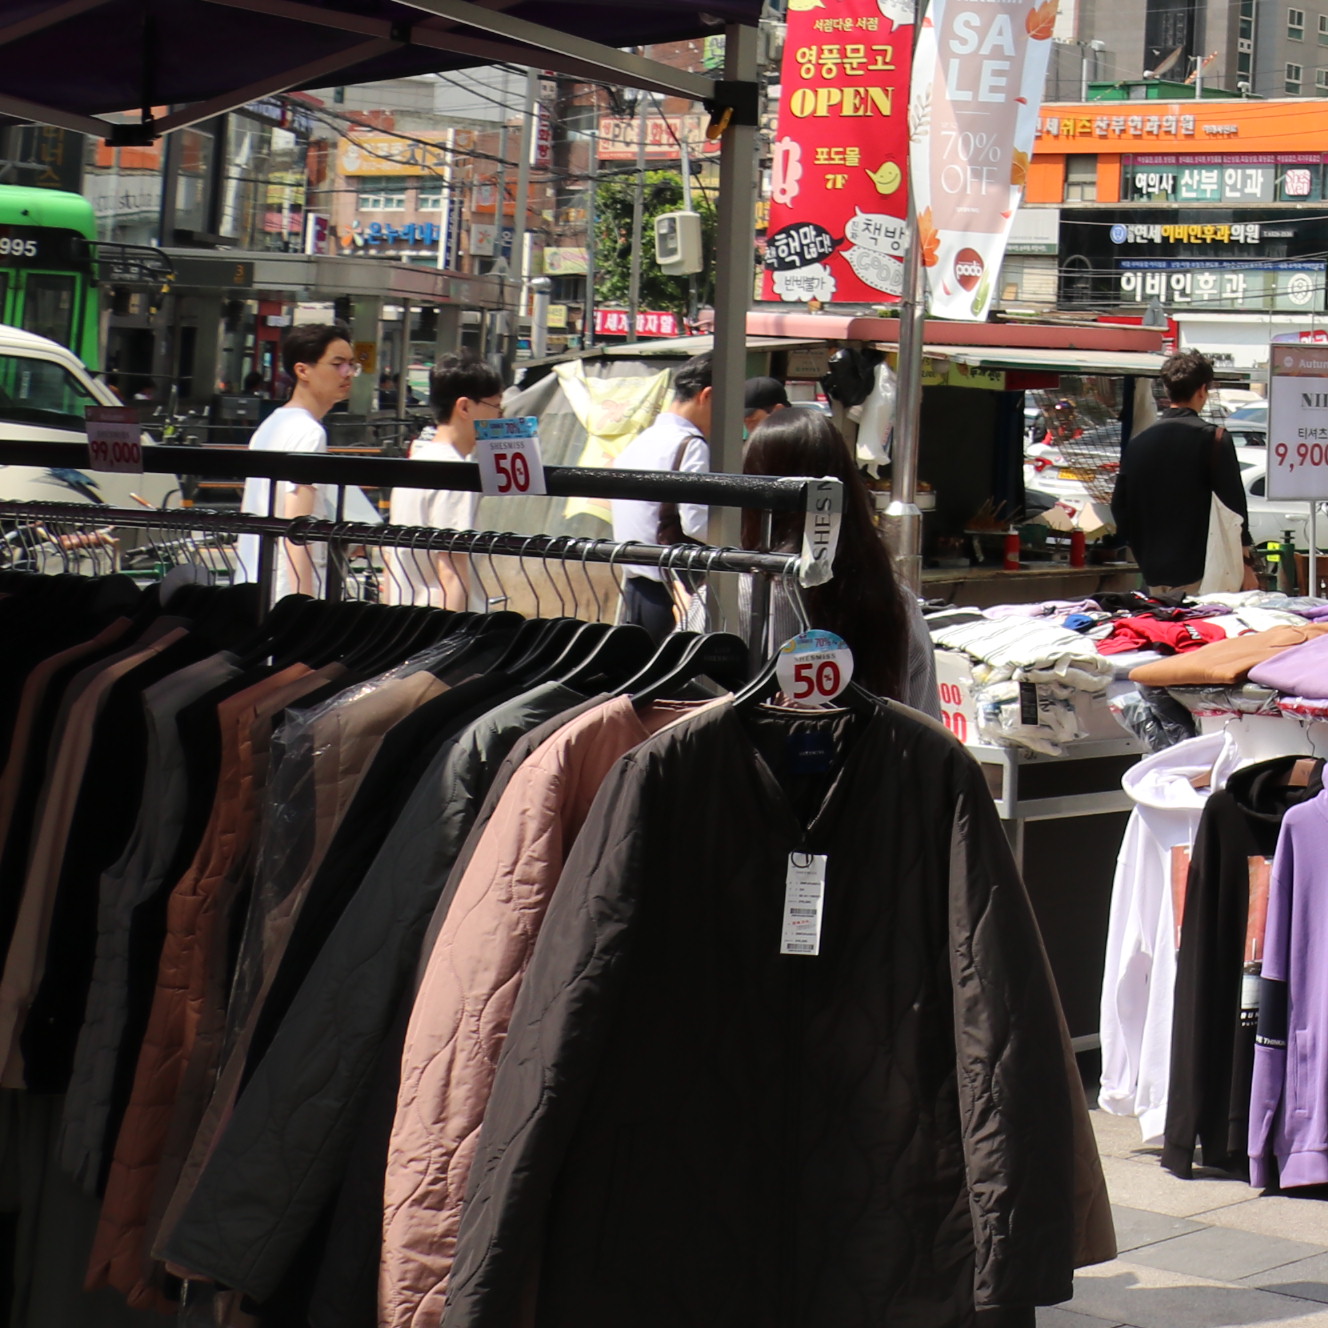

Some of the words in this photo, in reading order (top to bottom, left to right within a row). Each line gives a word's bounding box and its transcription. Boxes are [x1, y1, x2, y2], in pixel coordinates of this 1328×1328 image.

[813, 17, 854, 33] 서점다운
[855, 17, 879, 32] 서점
[795, 43, 896, 80] 영풍문고
[789, 86, 895, 118] OPEN
[813, 147, 861, 166] 포도몰
[940, 130, 1001, 163] 70%
[824, 173, 849, 190] 7F
[940, 164, 998, 195] OFF
[1134, 171, 1174, 194] 여의사
[1180, 168, 1264, 198] 산부인과
[784, 275, 827, 293] 반박불가
[1120, 272, 1247, 304] 이비인후과
[1298, 427, 1328, 440] 티셔츠
